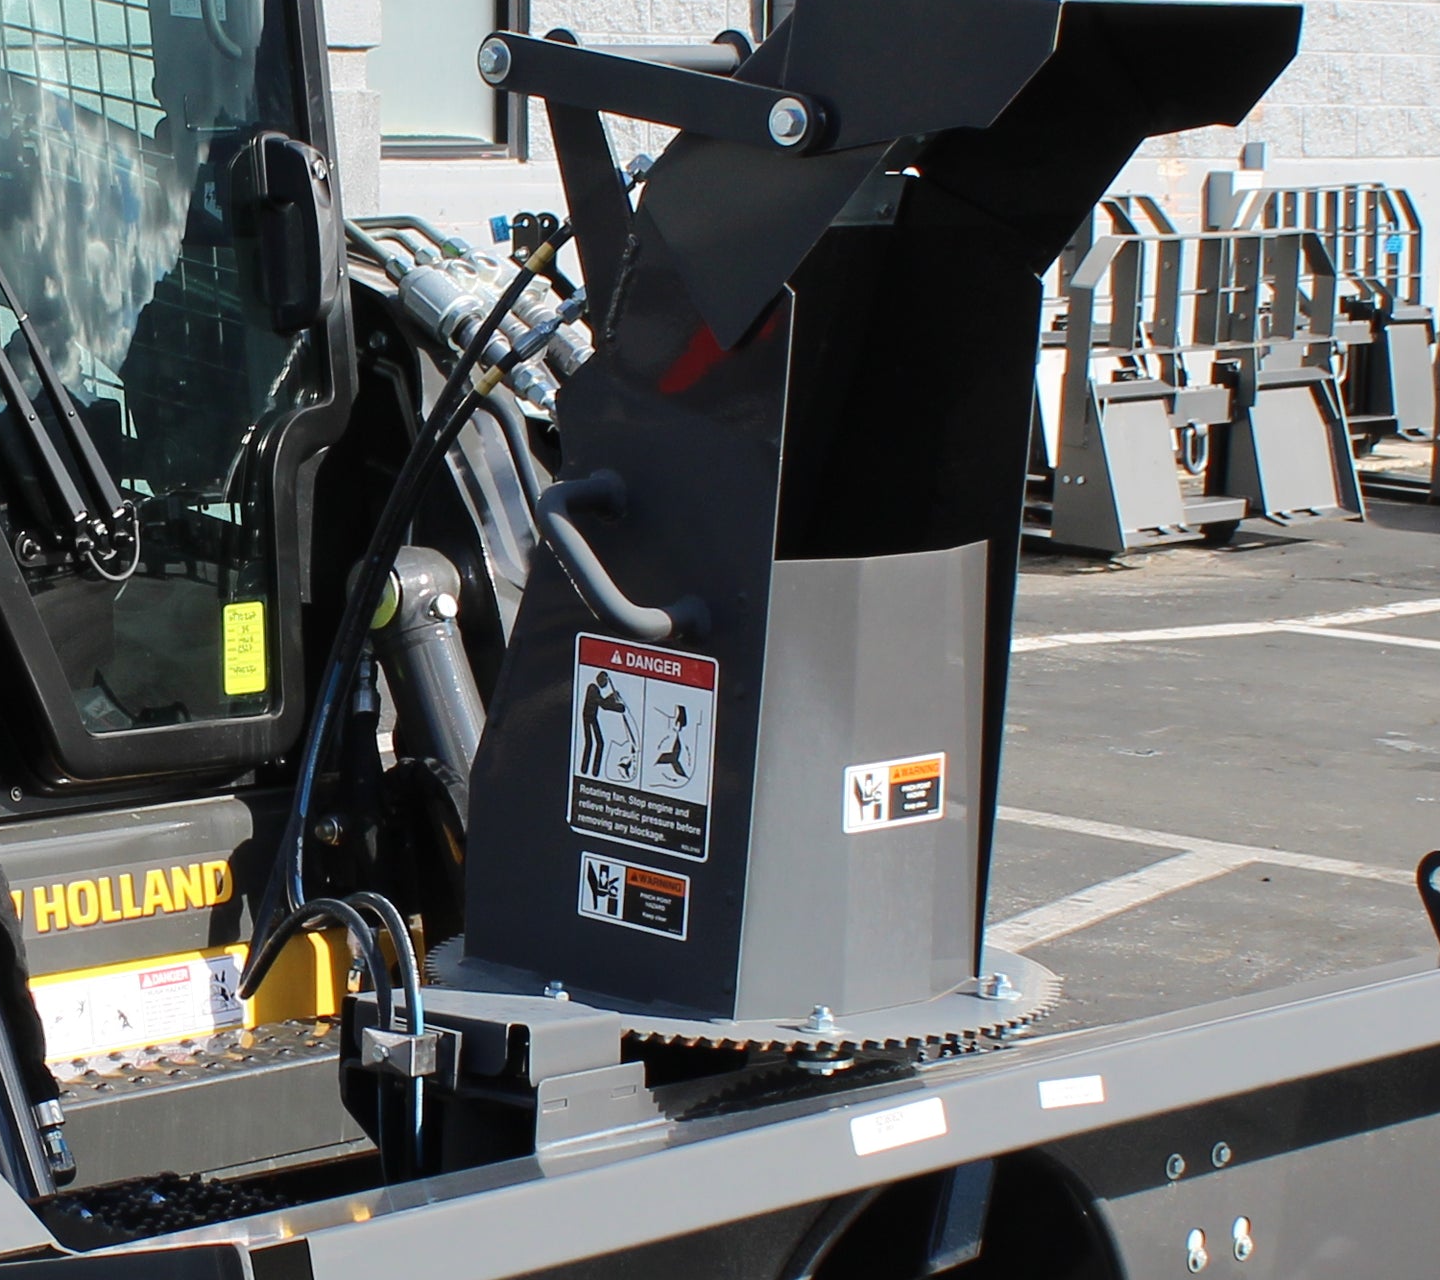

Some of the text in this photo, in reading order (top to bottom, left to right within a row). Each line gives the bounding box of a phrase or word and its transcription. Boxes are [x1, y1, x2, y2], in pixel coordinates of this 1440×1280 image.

[626, 652, 682, 677] DANGER
[901, 763, 939, 777] WARNING
[580, 784, 690, 818] Rotating fan. Stop engine and
[577, 814, 666, 842] removing any blockage.
[578, 799, 702, 835] relieve hydraulic pressure before
[637, 873, 681, 891] WARNING
[33, 859, 233, 933] HOLLAND
[151, 968, 189, 984] DANGER
